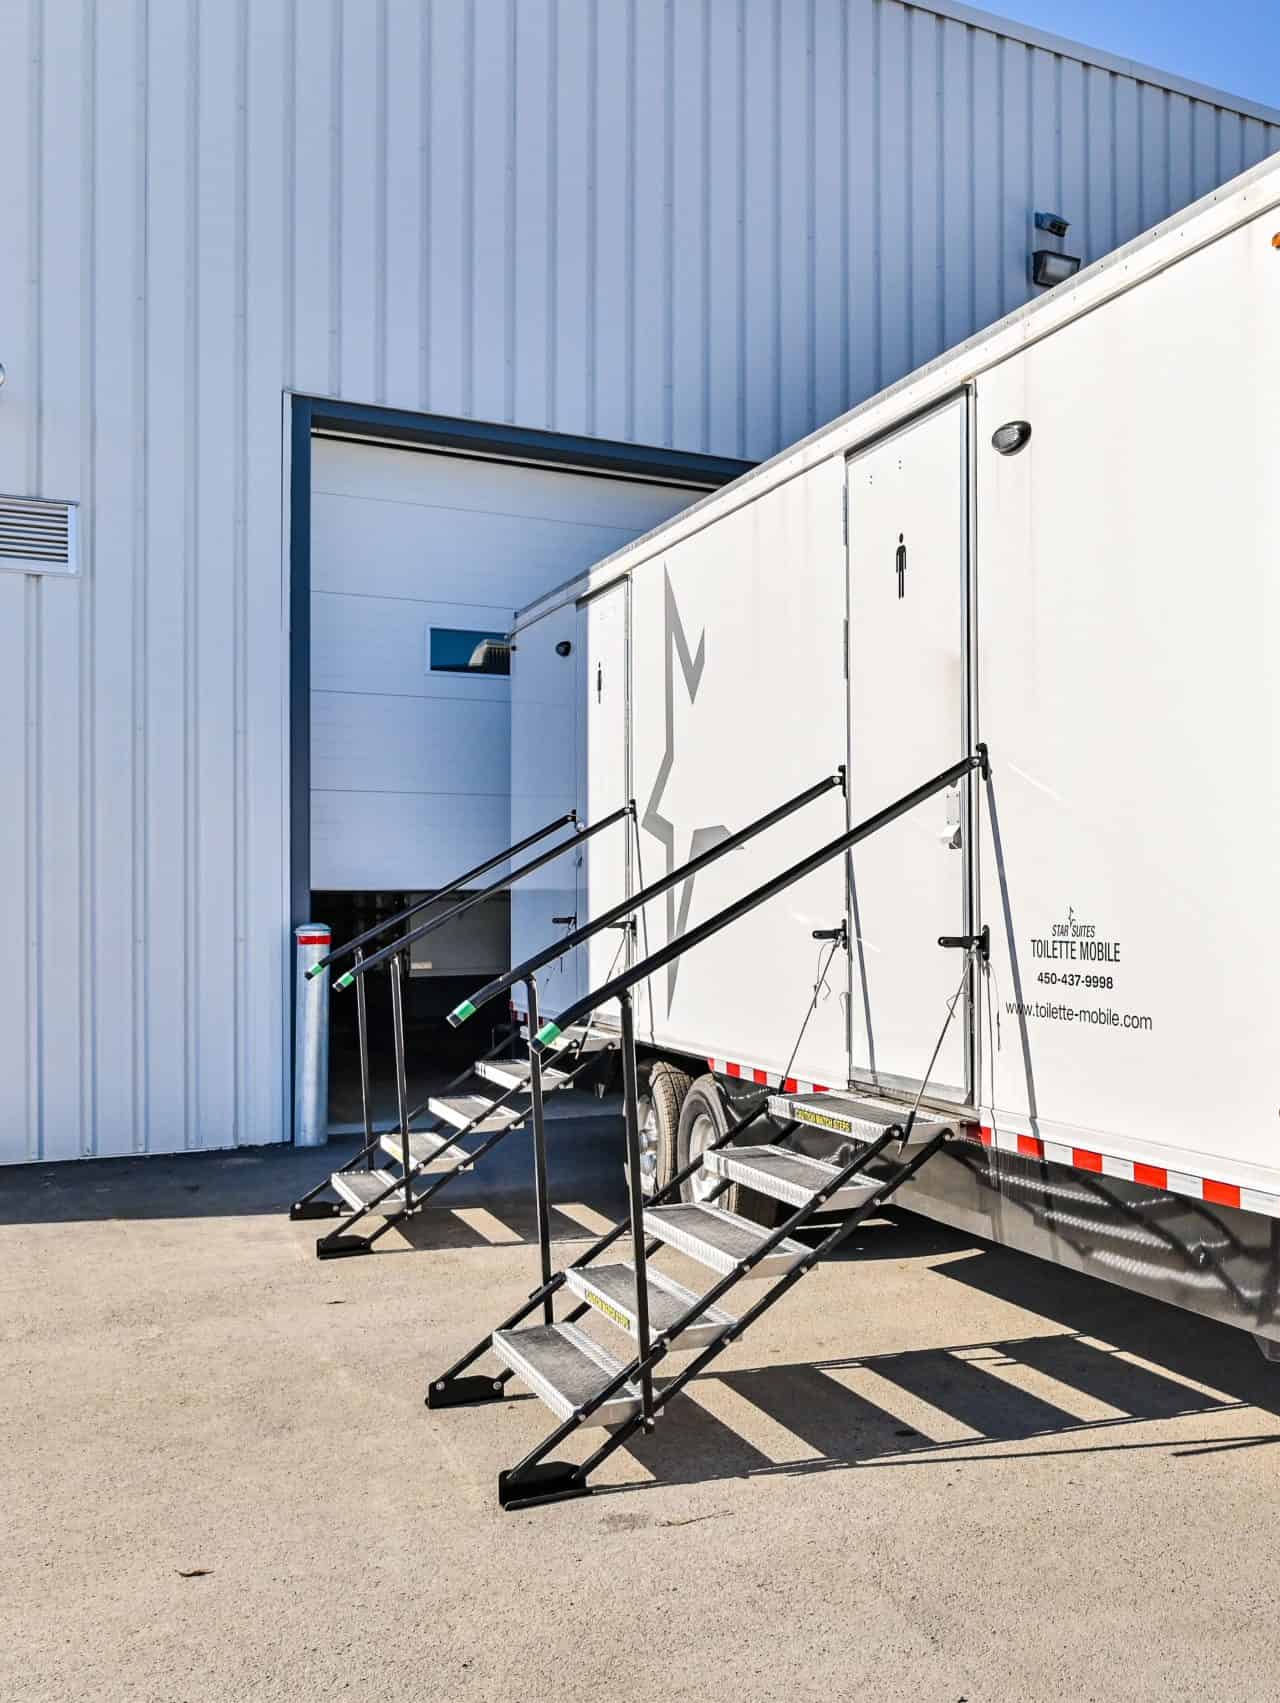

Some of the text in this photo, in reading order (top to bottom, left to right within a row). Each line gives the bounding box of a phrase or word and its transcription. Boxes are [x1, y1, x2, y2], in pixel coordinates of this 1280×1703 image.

[1052, 924, 1096, 938] STAR SUITES
[1030, 939, 1121, 962] TOILETTE MOBILE
[1037, 972, 1114, 989] 450-437-9998
[1005, 1001, 1153, 1031] www.toilette-mobile.com
